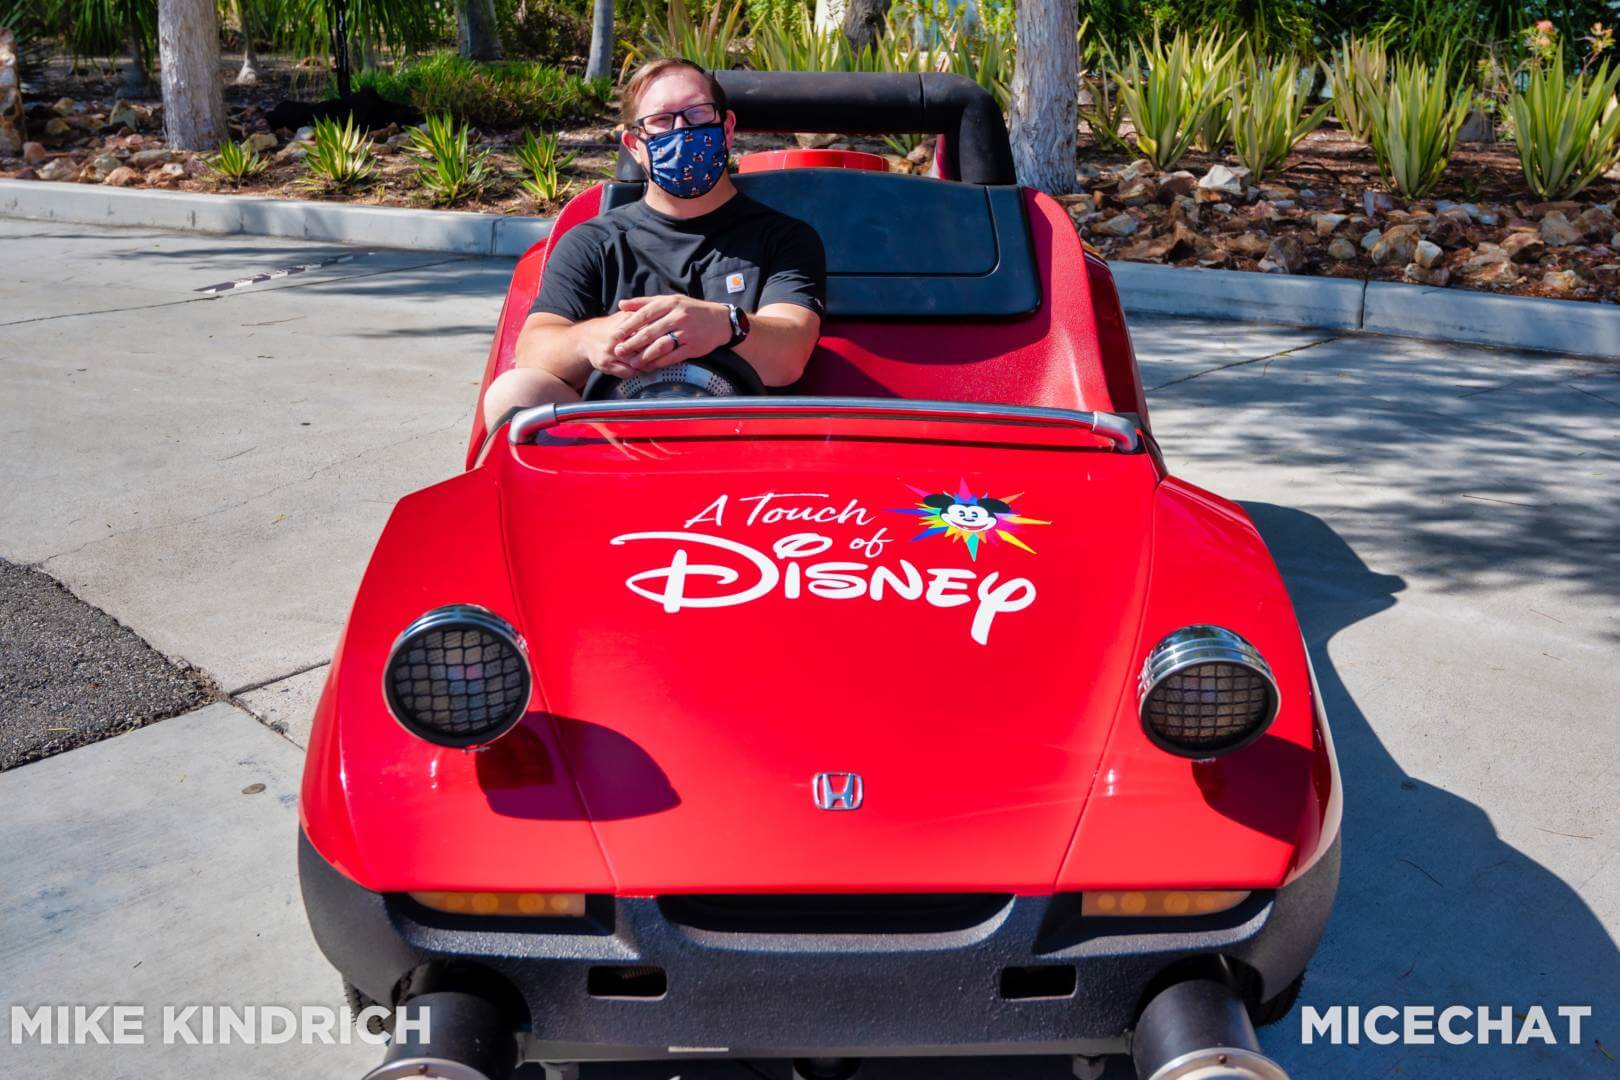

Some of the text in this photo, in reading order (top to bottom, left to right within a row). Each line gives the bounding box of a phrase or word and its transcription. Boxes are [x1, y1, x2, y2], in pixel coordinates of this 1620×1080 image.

[684, 491, 875, 529] A Touch
[848, 527, 894, 558] of
